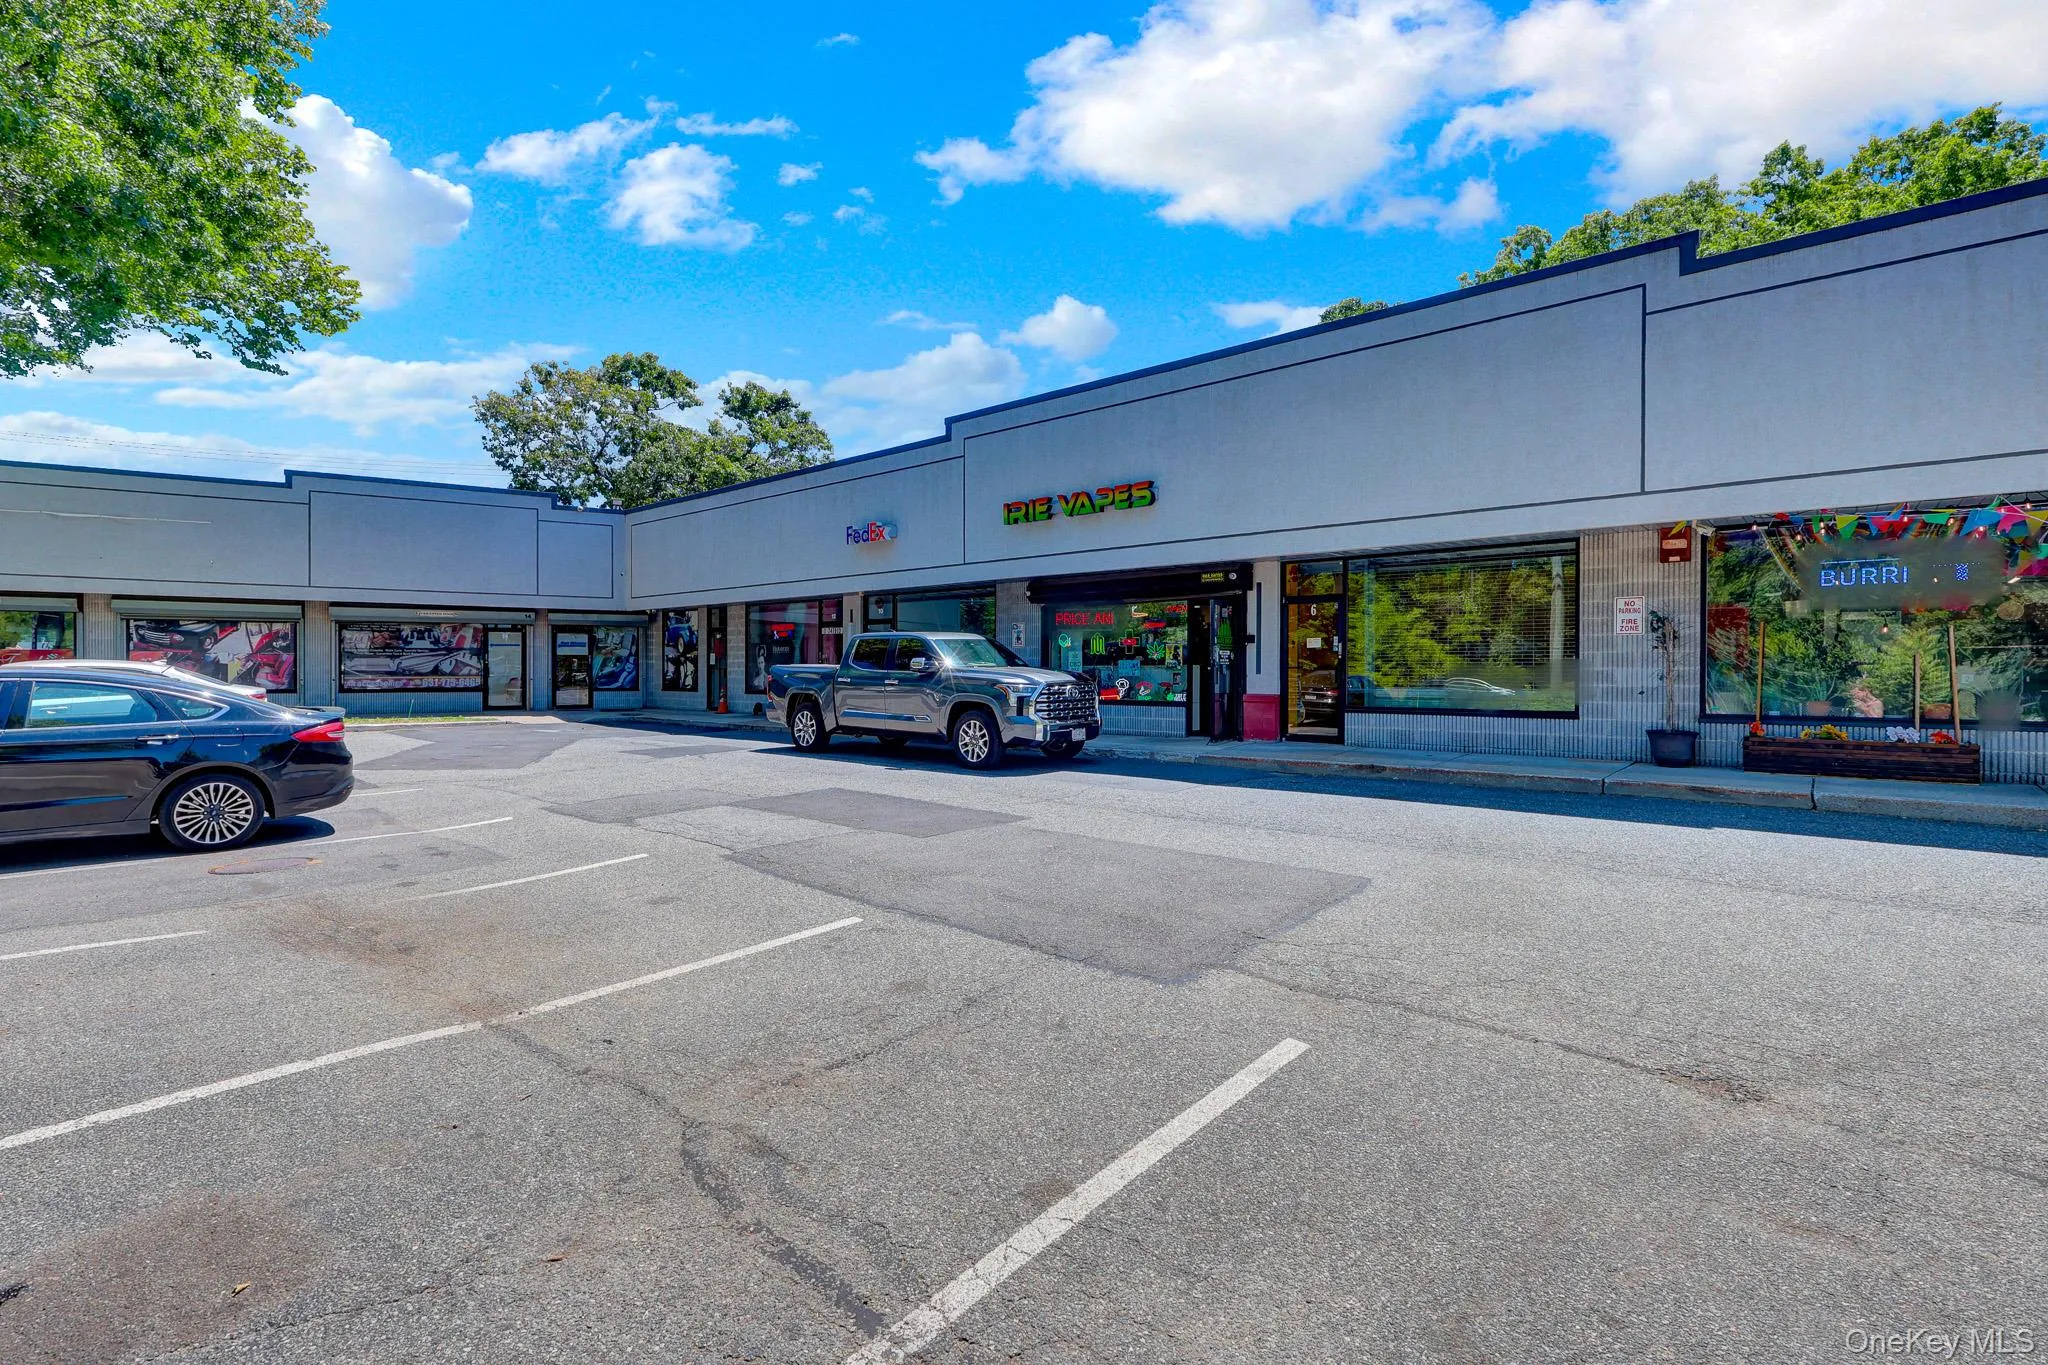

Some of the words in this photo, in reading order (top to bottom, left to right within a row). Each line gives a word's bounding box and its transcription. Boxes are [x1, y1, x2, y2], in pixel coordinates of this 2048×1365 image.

[1003, 496, 1052, 525] IRIE
[1057, 480, 1156, 517] VAPES
[846, 521, 887, 545] FedEx
[1820, 566, 1908, 587] BURRI
[1055, 611, 1090, 625] PRICE
[1310, 603, 1317, 616] 6
